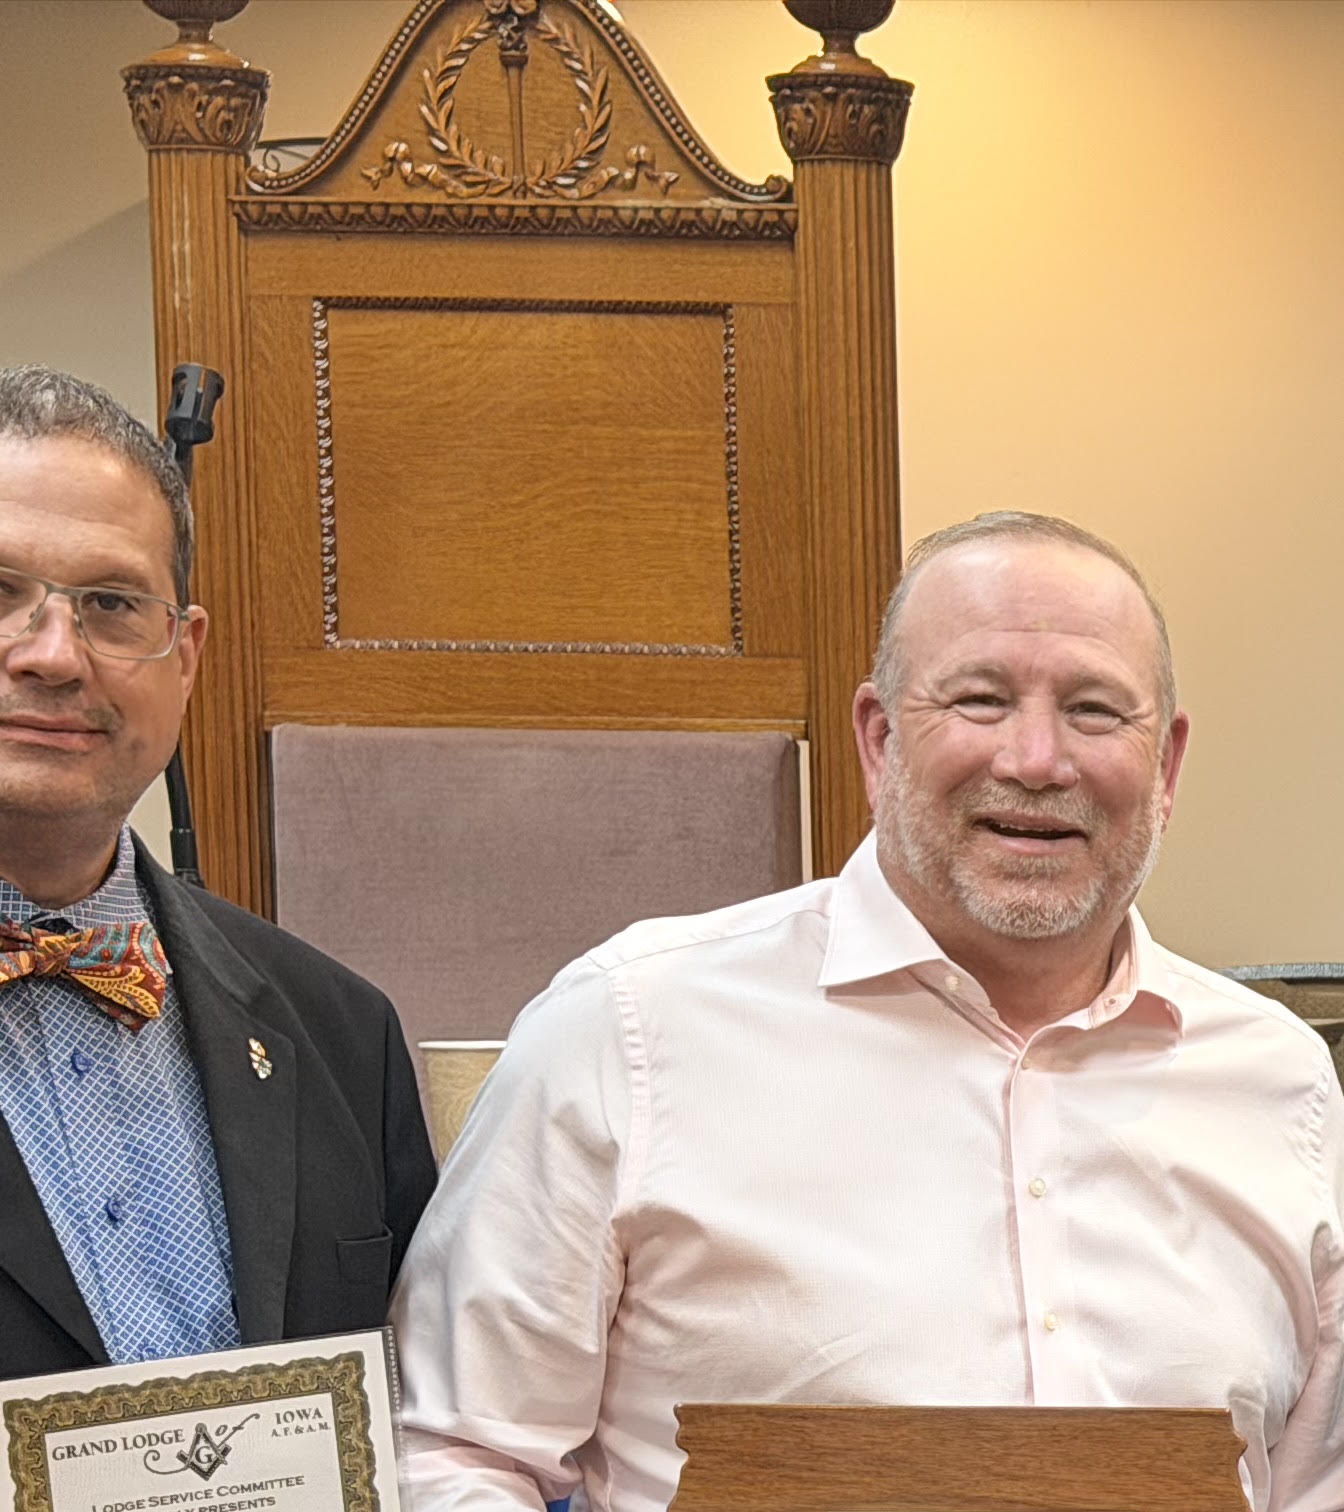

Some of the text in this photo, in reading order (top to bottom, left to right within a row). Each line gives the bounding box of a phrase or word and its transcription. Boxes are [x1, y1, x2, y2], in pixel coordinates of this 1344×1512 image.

[275, 1408, 323, 1425] IOWA
[52, 1439, 117, 1461] GRAND
[120, 1429, 185, 1450] LODGE
[148, 1489, 214, 1507] SERVICE
[217, 1475, 305, 1497] COMMITTEE
